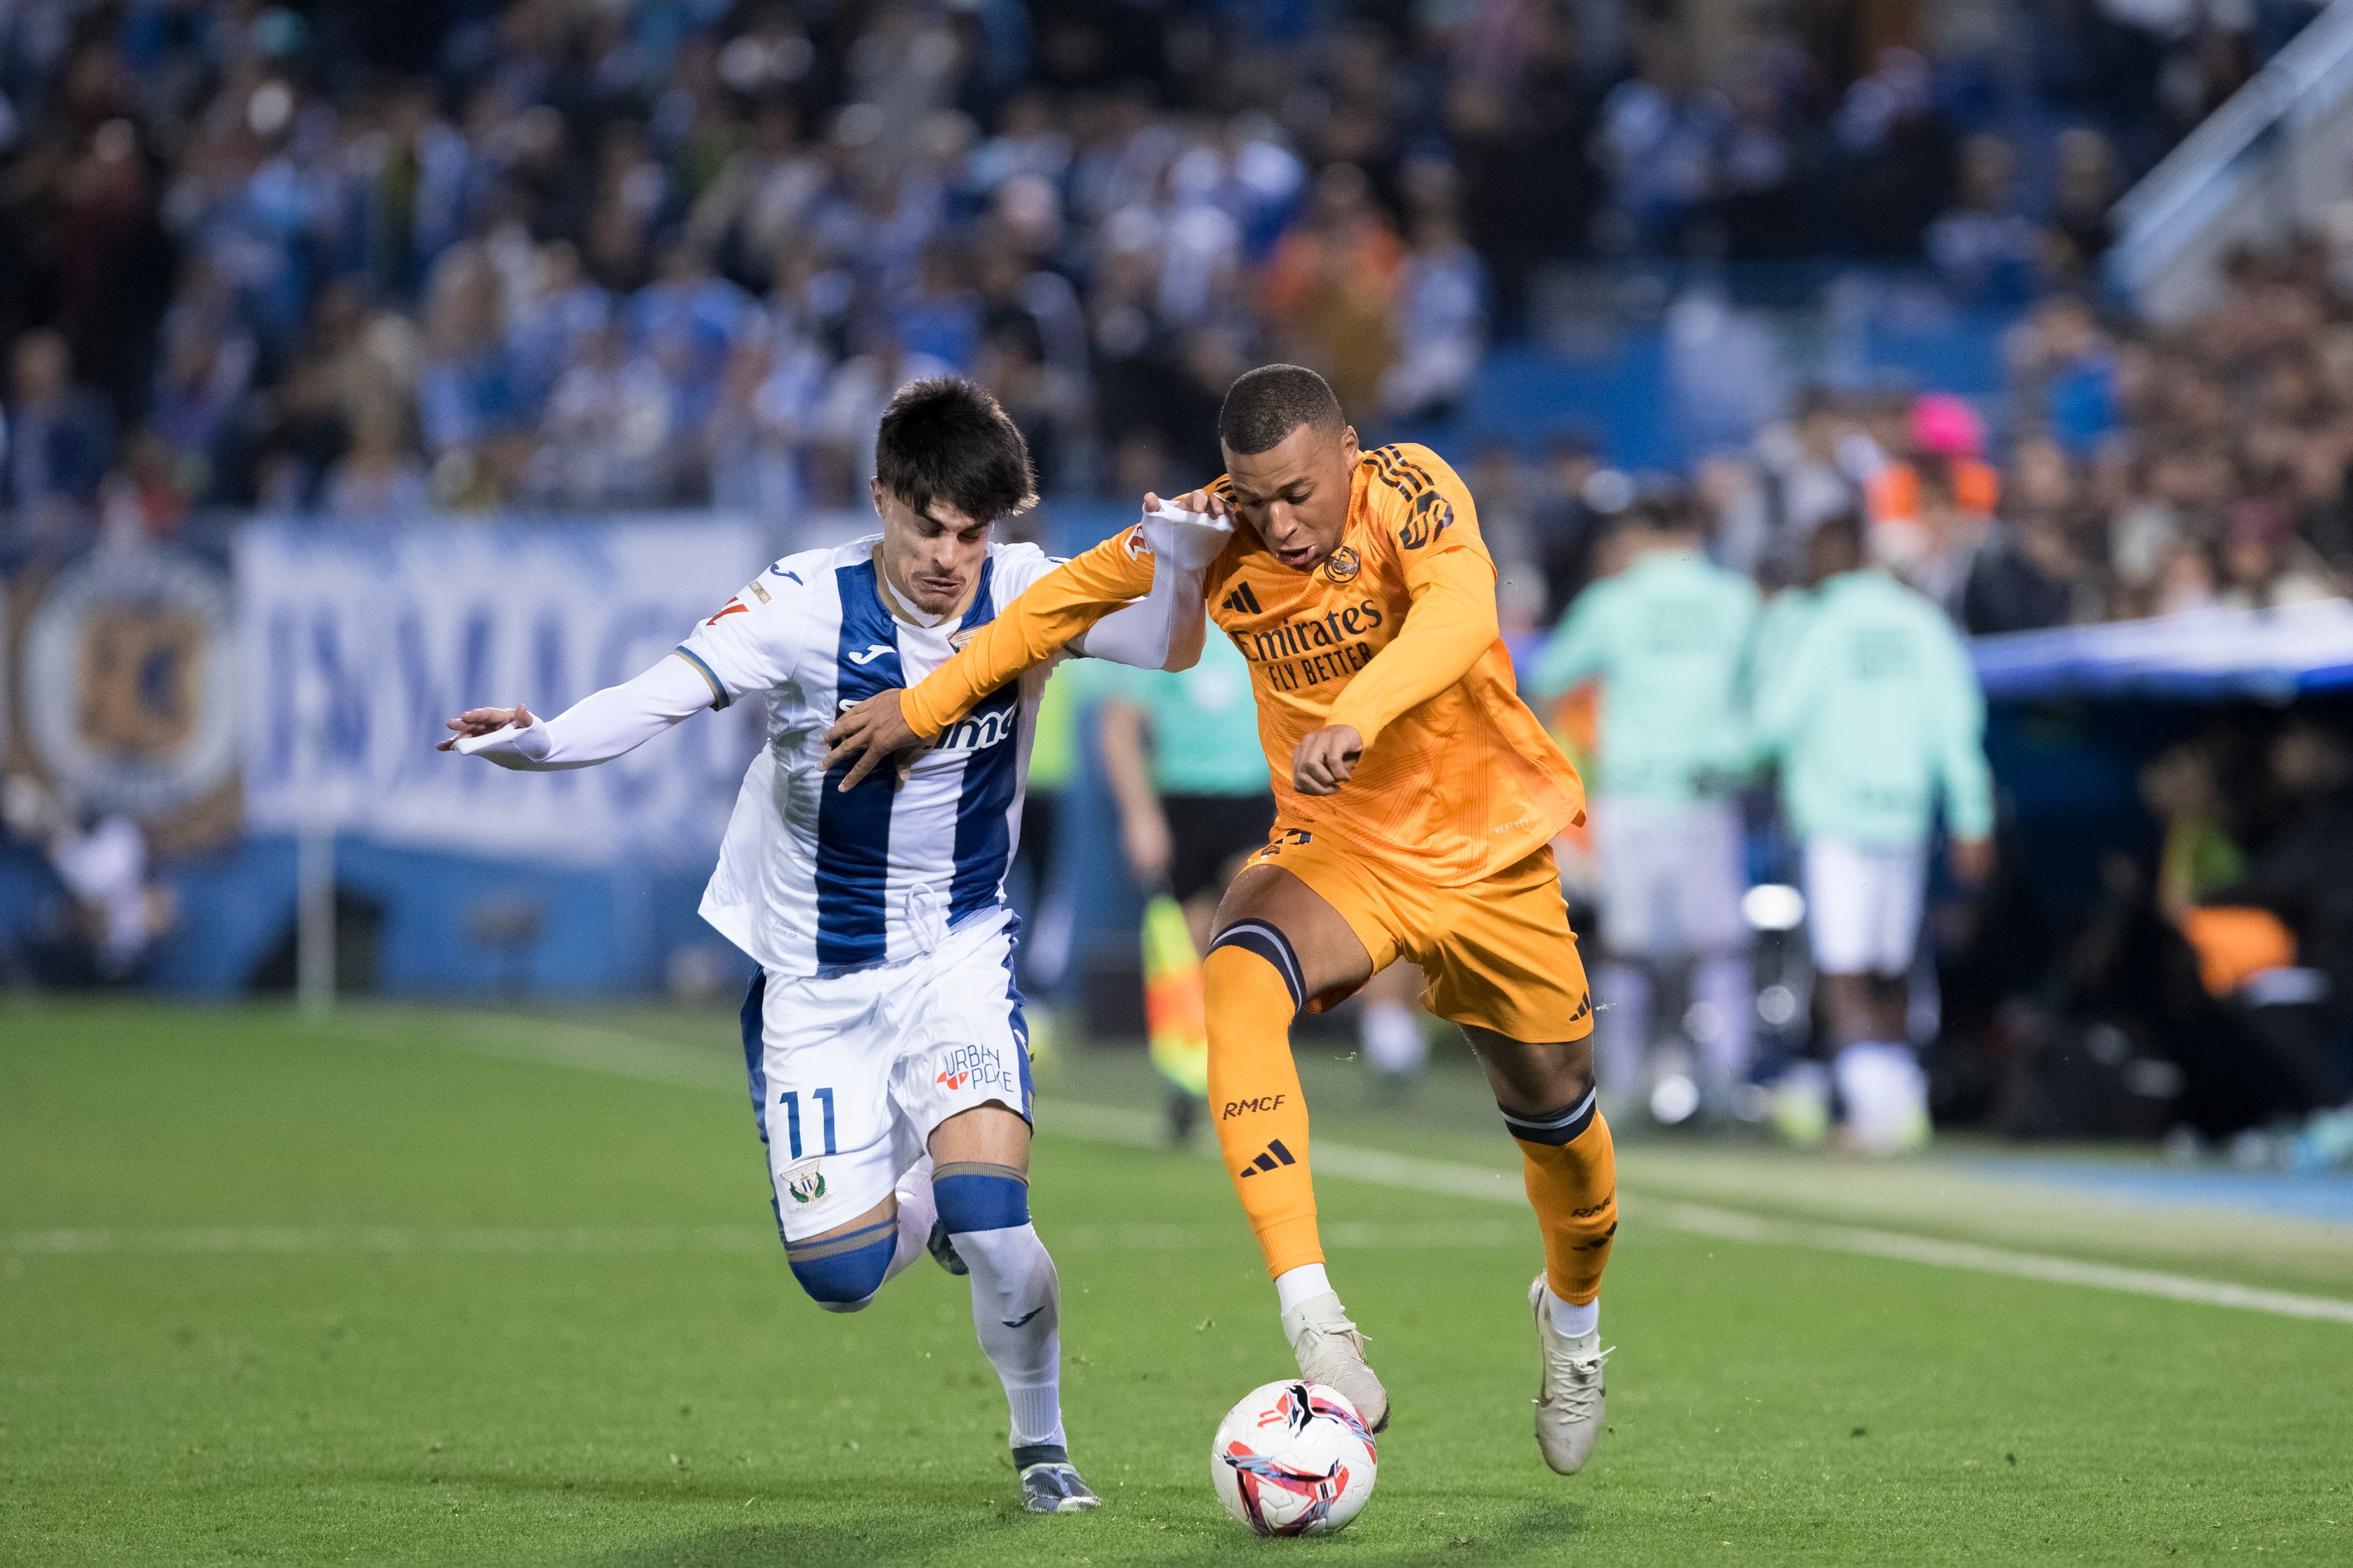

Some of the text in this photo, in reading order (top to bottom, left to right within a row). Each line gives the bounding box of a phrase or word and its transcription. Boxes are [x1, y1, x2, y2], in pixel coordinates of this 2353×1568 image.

[1229, 599, 1383, 662] Emirates
[1268, 642, 1374, 691] FLY BETTER
[944, 1043, 1000, 1076] URBAN
[971, 1063, 1014, 1092] POKE
[779, 1087, 837, 1160] 11
[1223, 1094, 1285, 1120] RMCF
